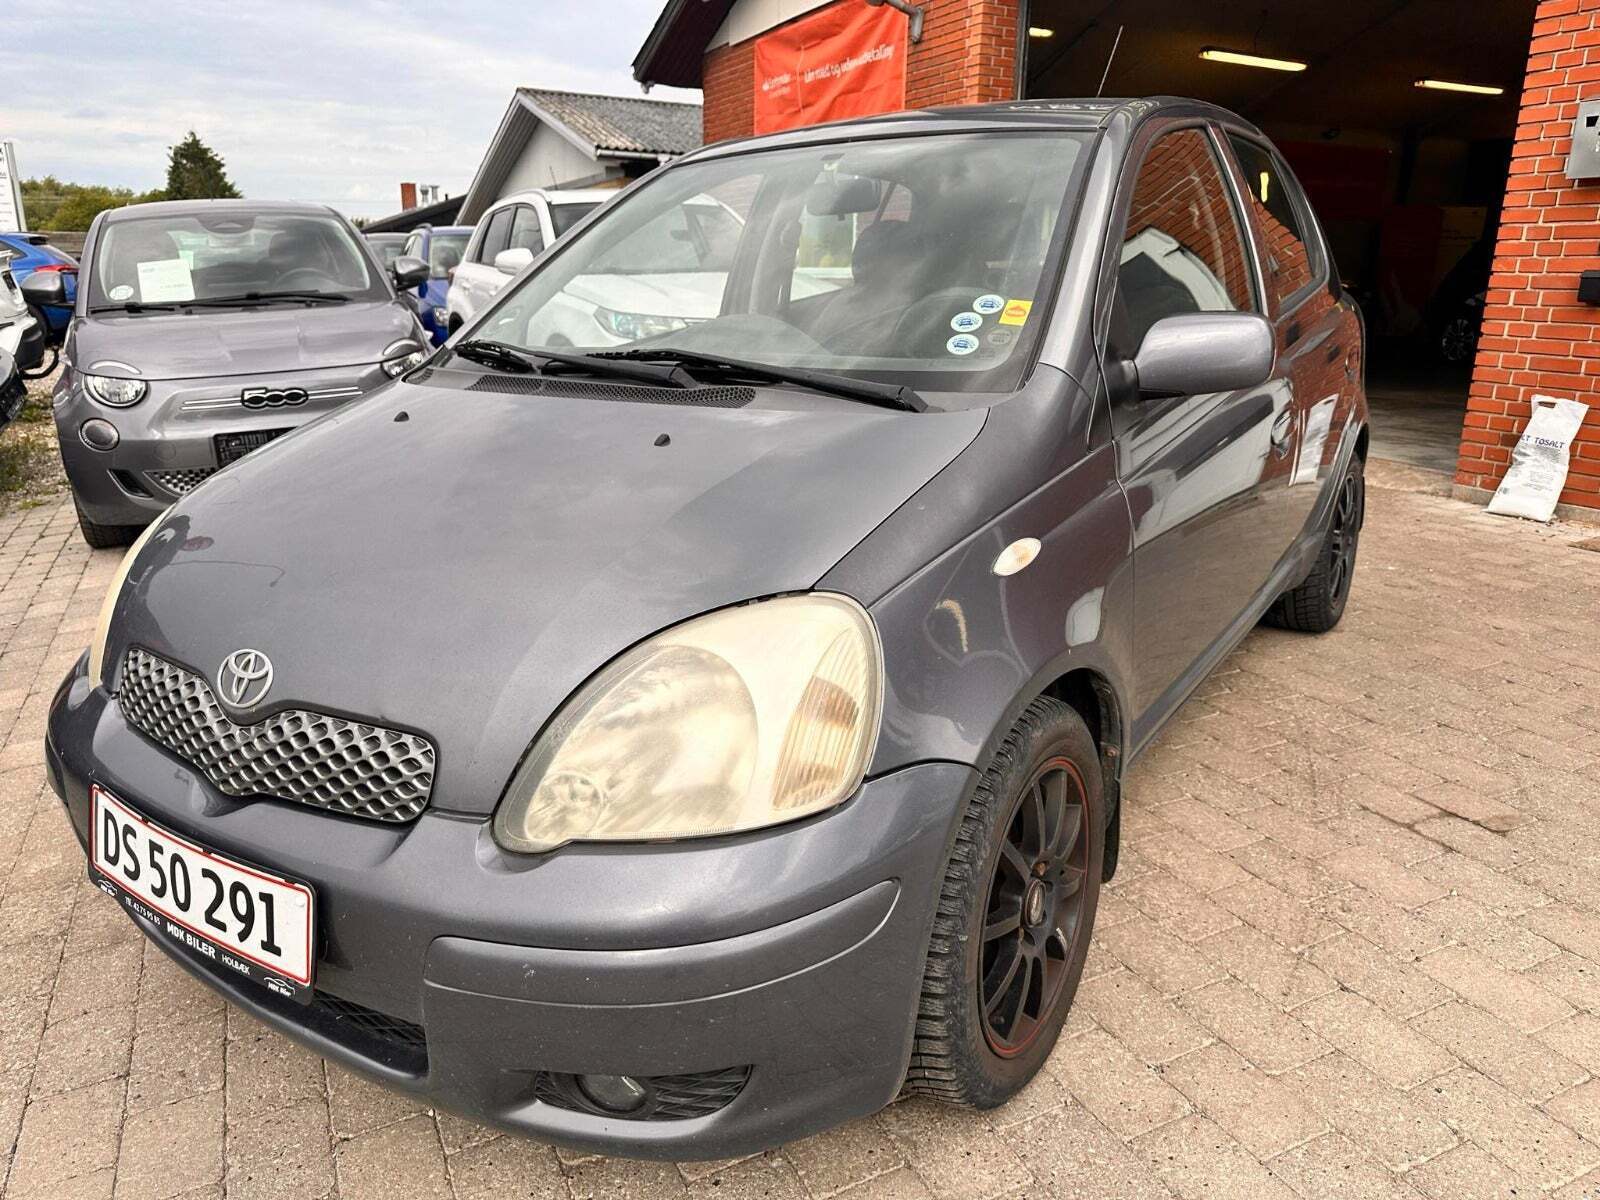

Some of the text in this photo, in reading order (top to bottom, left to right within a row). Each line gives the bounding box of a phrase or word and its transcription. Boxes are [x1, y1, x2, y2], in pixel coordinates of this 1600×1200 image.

[242, 387, 308, 409] 500
[104, 808, 281, 957] DS 50 291
[167, 922, 216, 959] MDK BILER
